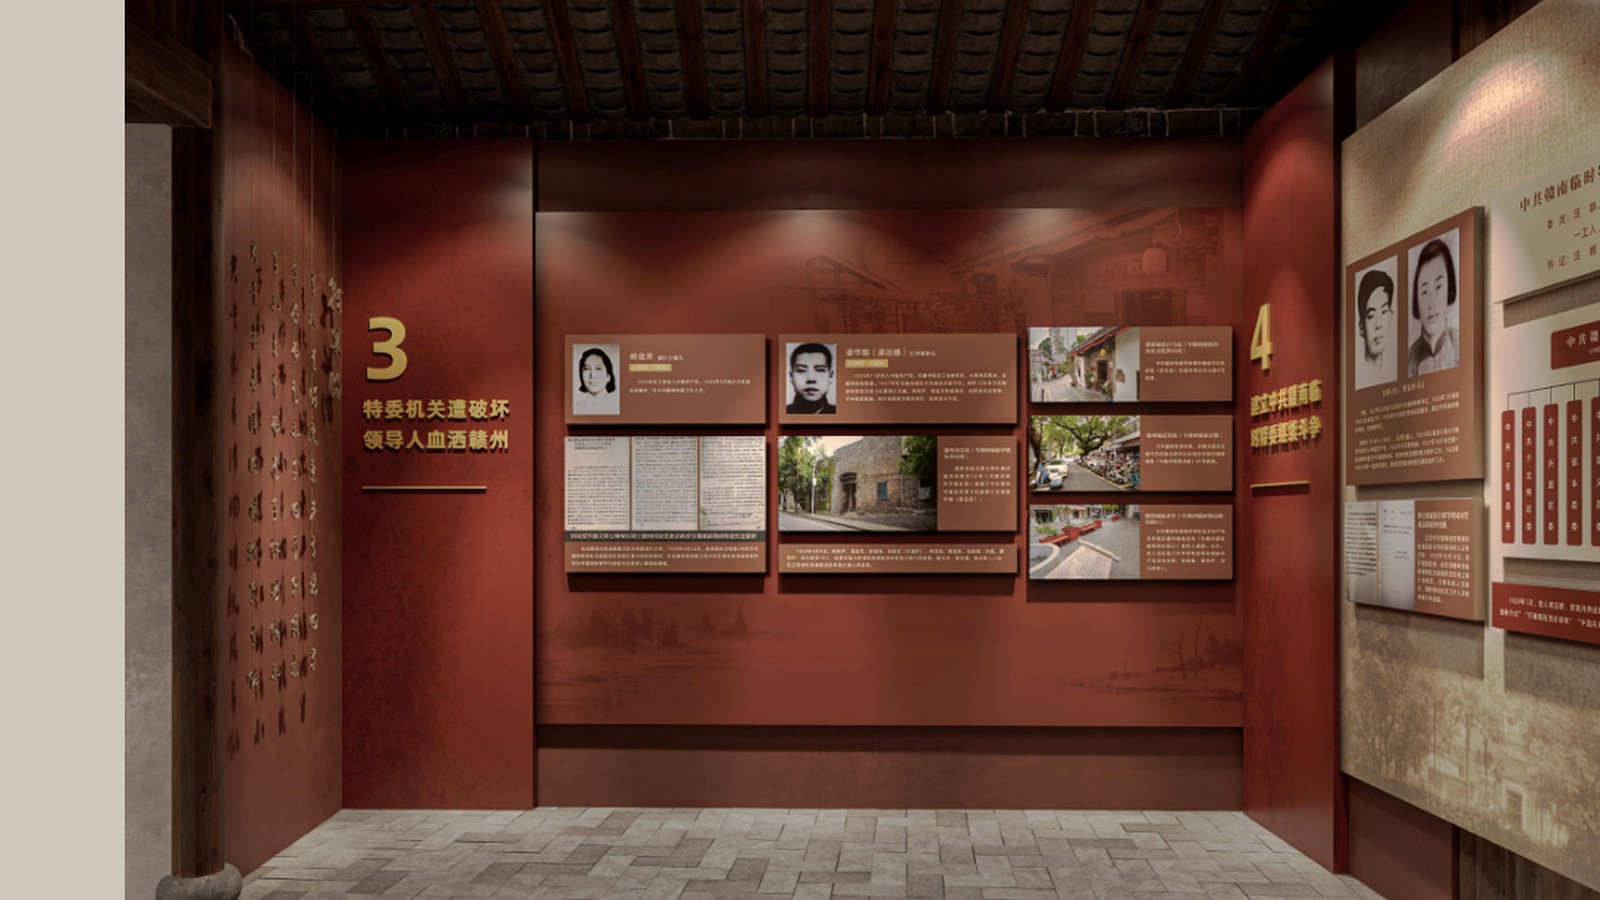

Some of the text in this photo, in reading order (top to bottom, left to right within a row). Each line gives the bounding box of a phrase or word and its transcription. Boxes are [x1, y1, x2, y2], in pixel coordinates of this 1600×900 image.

[366, 316, 409, 381] 3
[1250, 303, 1274, 372] 4
[362, 399, 510, 420] 特委机关遭破坏
[362, 429, 509, 450] 领导人血洒赣州
